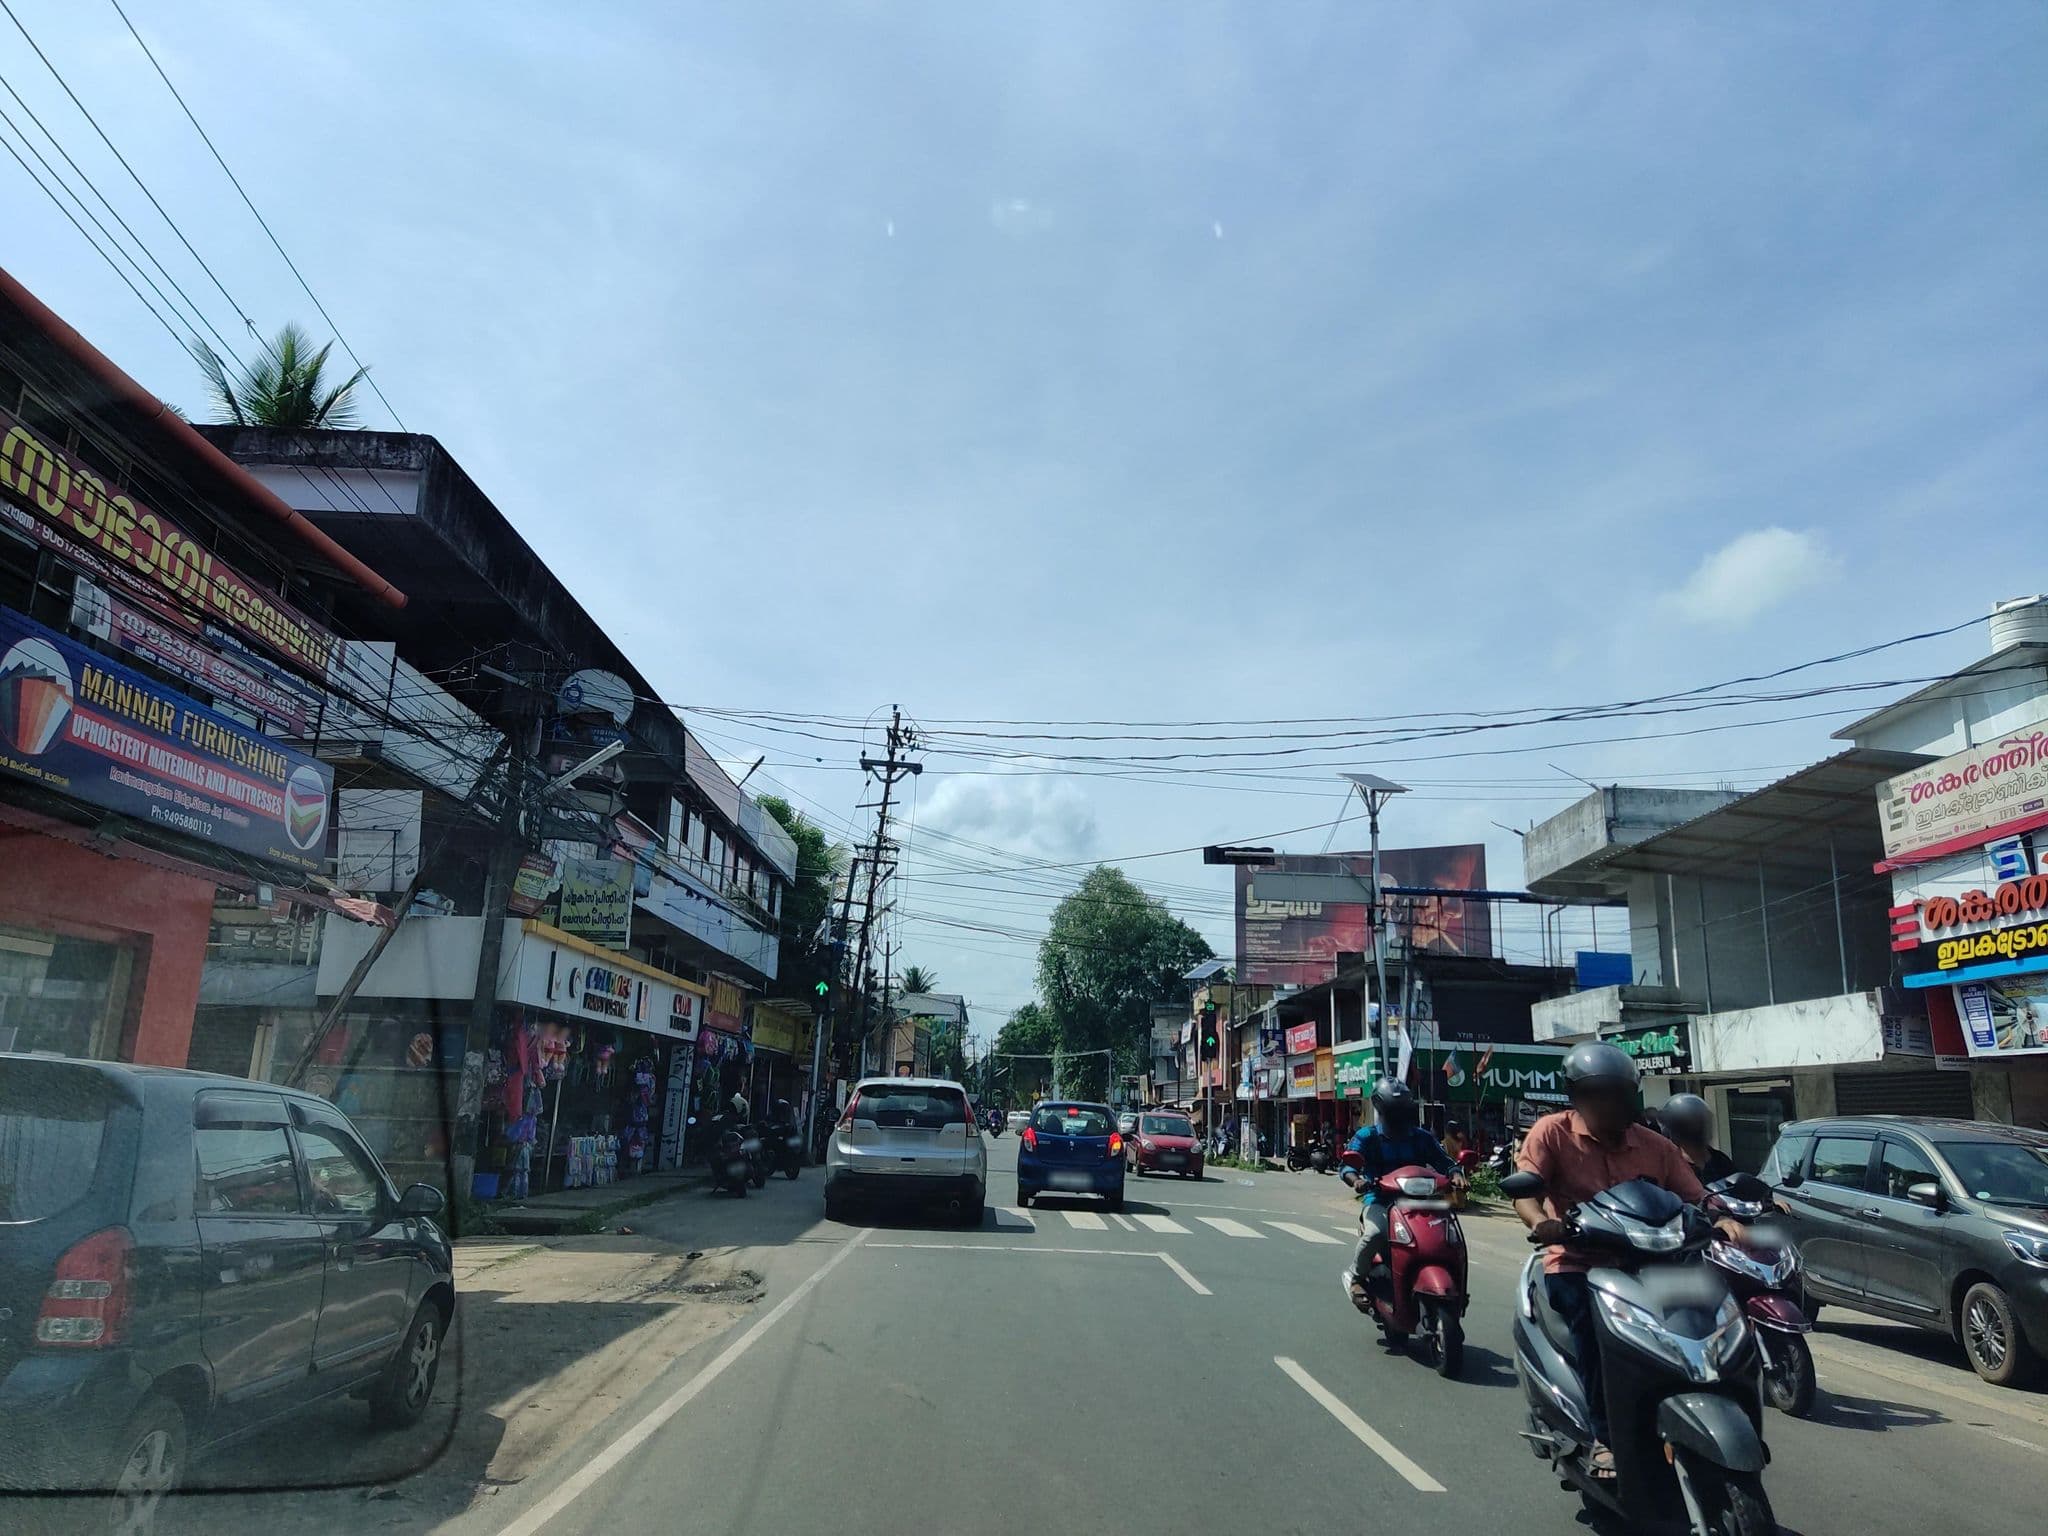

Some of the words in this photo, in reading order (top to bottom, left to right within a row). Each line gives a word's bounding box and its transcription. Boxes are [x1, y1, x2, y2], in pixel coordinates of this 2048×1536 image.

[72, 713, 149, 763] UPHOLSTERY
[148, 746, 205, 788] MATERIALS
[205, 768, 225, 795] AND
[227, 777, 282, 816] MATTRESSES
[80, 664, 175, 735] MANNAR
[180, 710, 288, 783] FURNISHING
[1638, 1056, 1665, 1070] DEALERS
